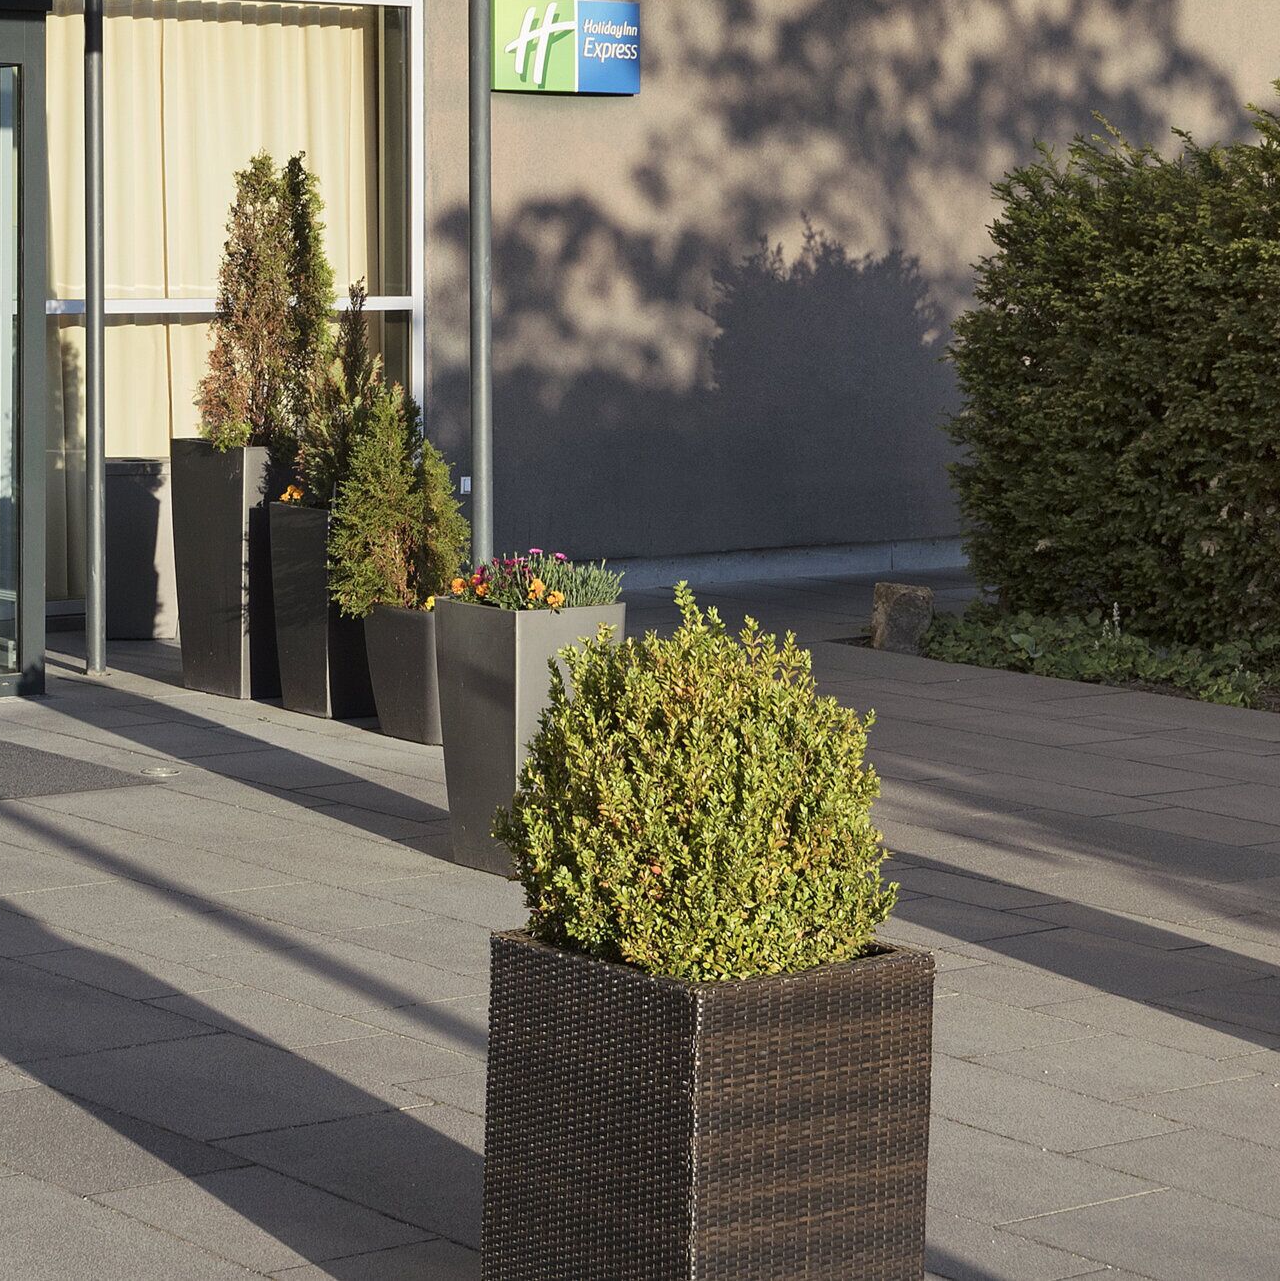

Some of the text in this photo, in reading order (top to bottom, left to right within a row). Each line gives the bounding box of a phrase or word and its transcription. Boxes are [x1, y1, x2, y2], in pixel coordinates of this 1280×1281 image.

[584, 19, 637, 38] Holiday Inn
[584, 37, 637, 62] Express
